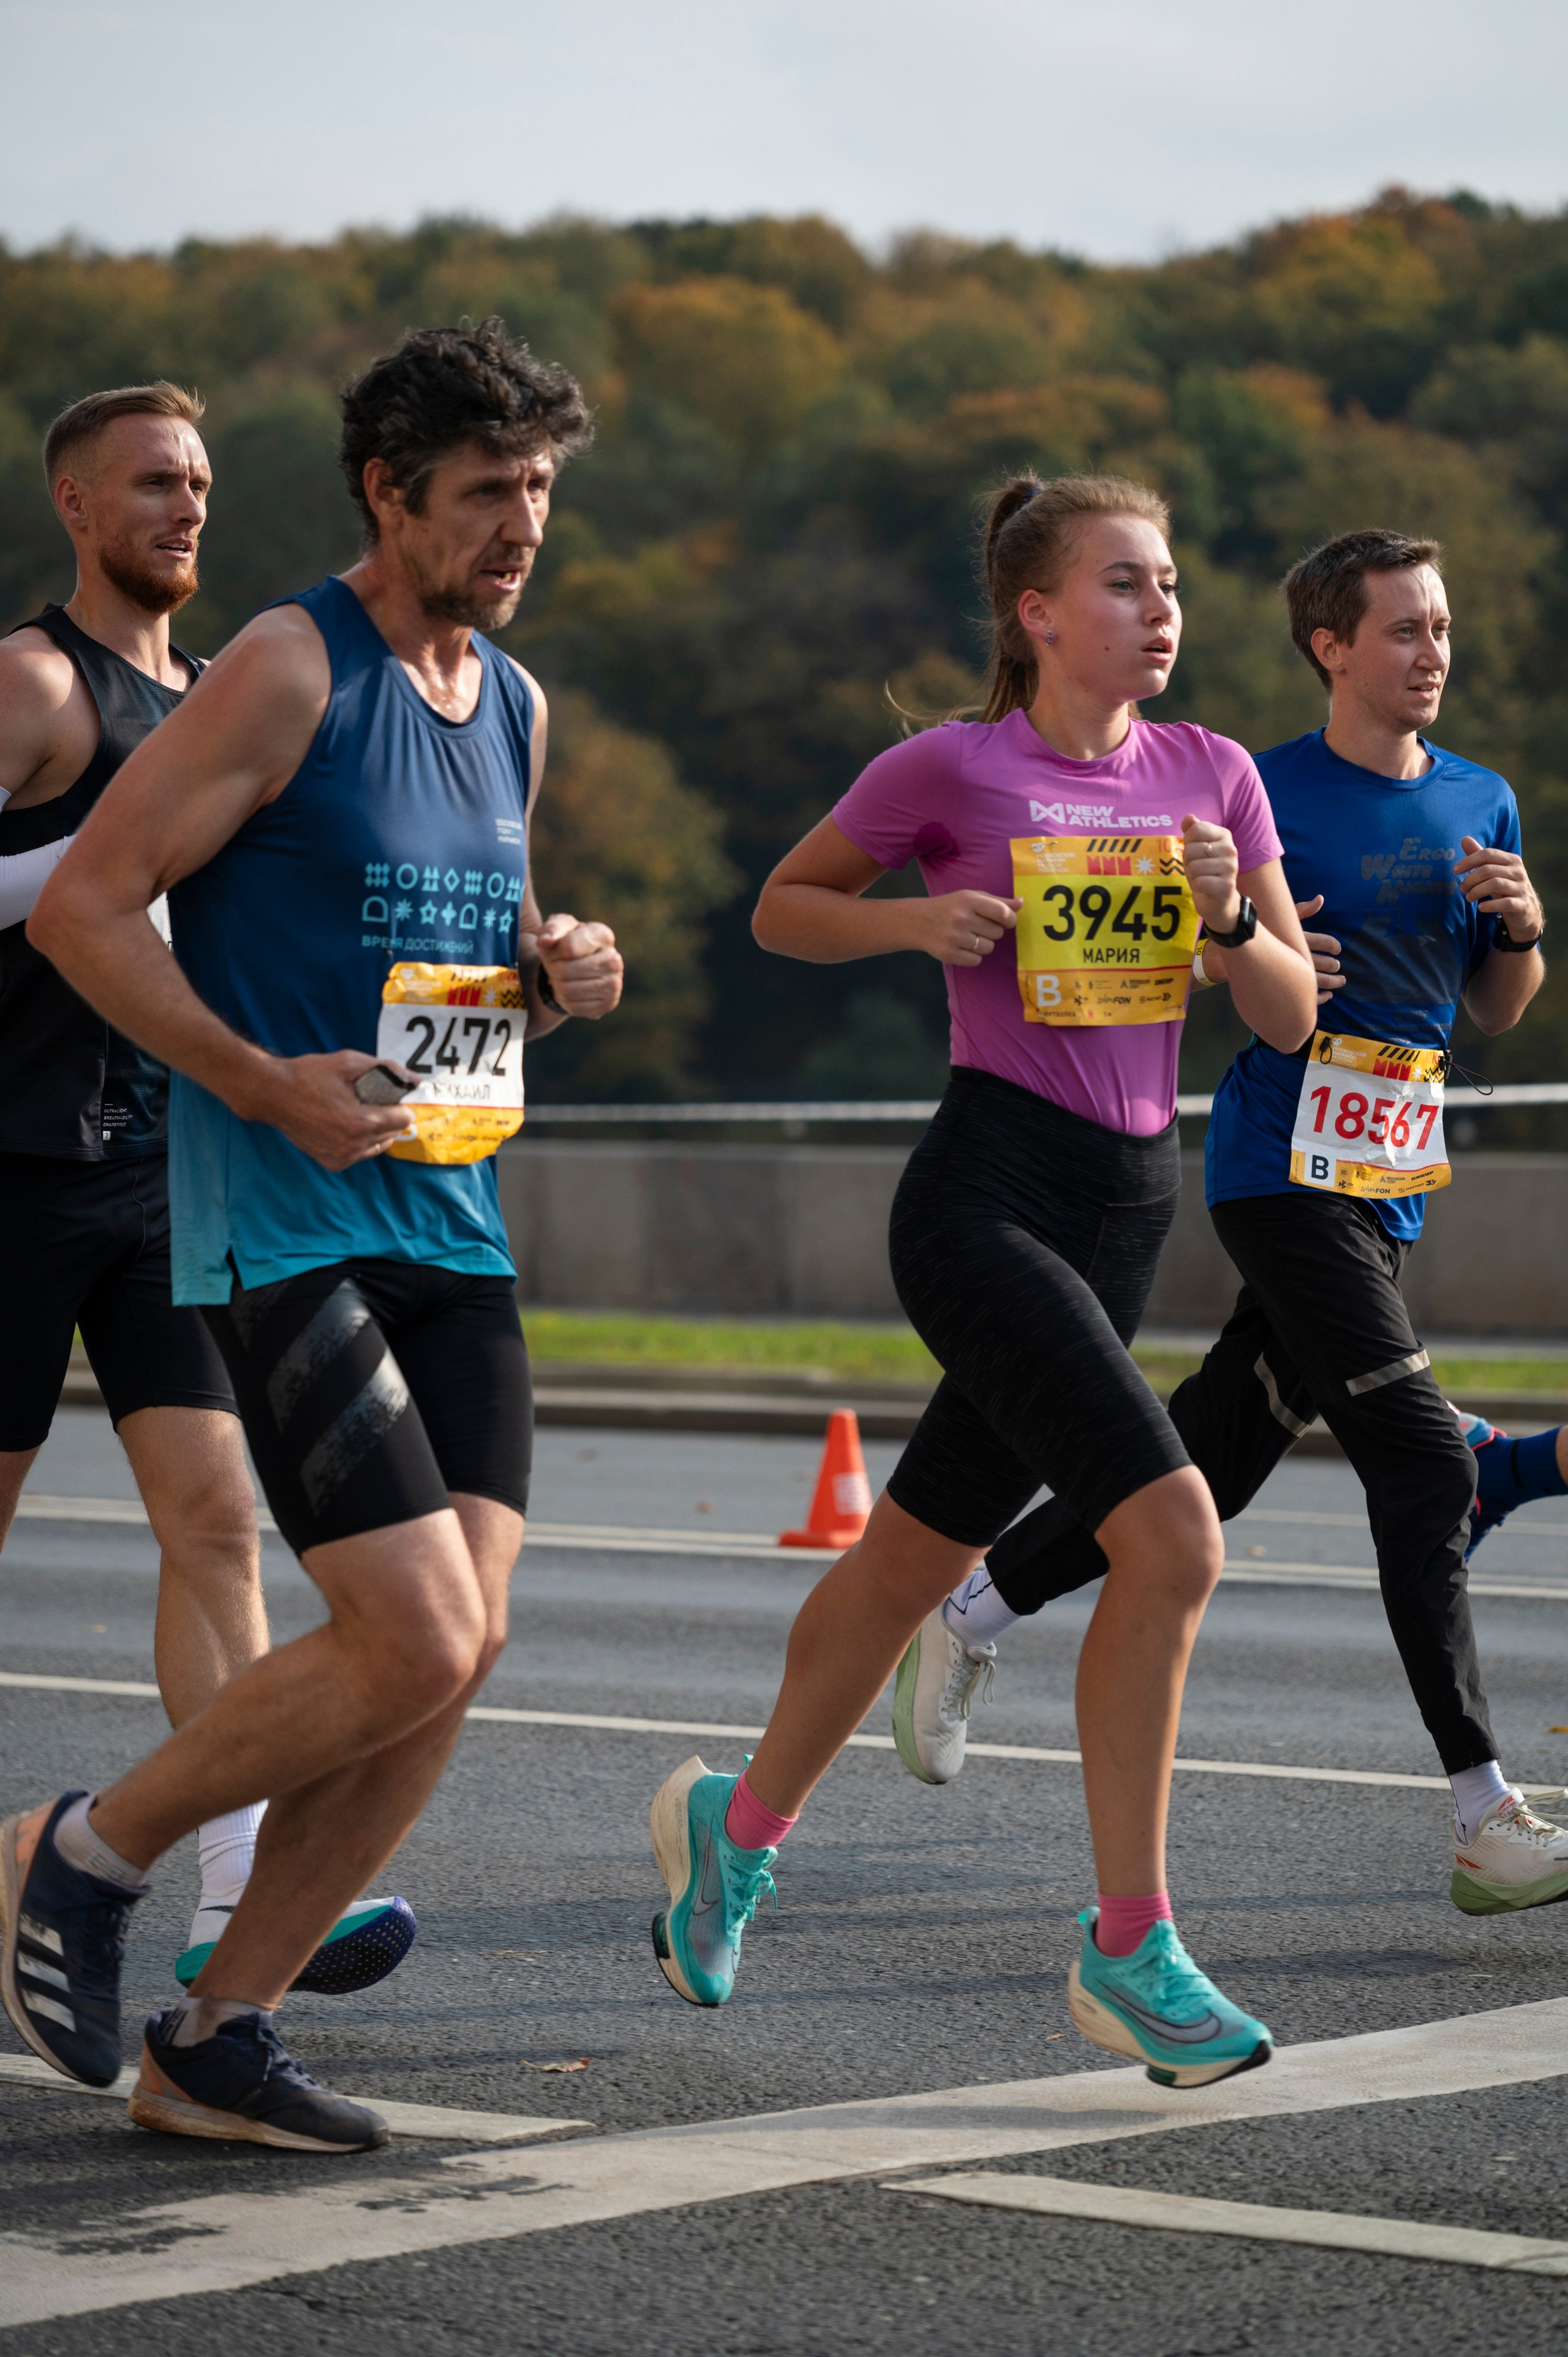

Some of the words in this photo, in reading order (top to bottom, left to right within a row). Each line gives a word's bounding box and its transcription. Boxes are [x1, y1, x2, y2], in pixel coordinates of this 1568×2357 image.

[1066, 804, 1115, 816] NEW
[1069, 815, 1173, 828] ATHLETICS
[1043, 885, 1182, 941] 3945
[1083, 948, 1140, 963] МАРИЯ
[405, 1016, 511, 1076] 2472
[1310, 1085, 1439, 1150] 18567
